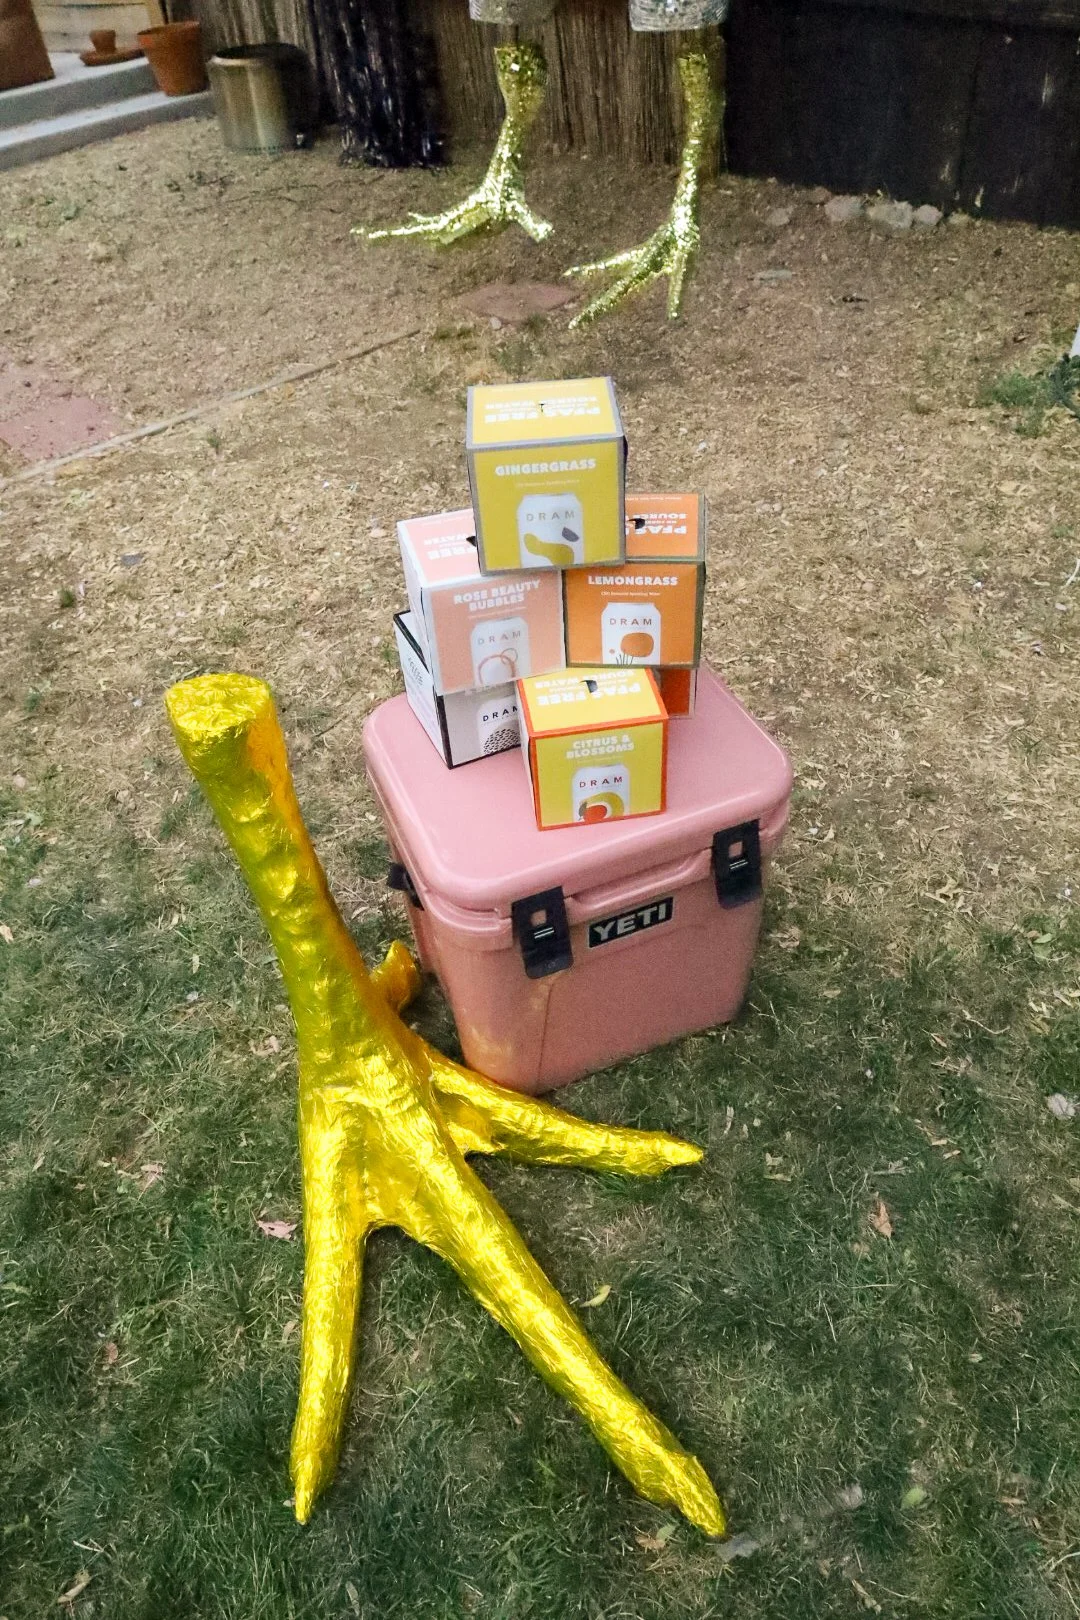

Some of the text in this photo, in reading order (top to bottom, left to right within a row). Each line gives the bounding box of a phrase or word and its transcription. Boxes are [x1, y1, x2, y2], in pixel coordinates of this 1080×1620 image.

[495, 459, 597, 476] GINGERGRASS
[526, 510, 576, 522] DRAM
[588, 575, 679, 586] LEMONGRASS
[454, 579, 541, 605] ROSE BEAUTY
[469, 593, 525, 611] BUBBLES
[609, 618, 652, 626] DRAM
[478, 630, 521, 645] DRAM
[535, 677, 579, 689] WATER
[536, 691, 587, 707] FREE
[573, 734, 630, 749] CITRUS &
[566, 742, 634, 759] BLOSSOMS
[579, 776, 623, 788] DRAM
[593, 903, 666, 941] YETI
